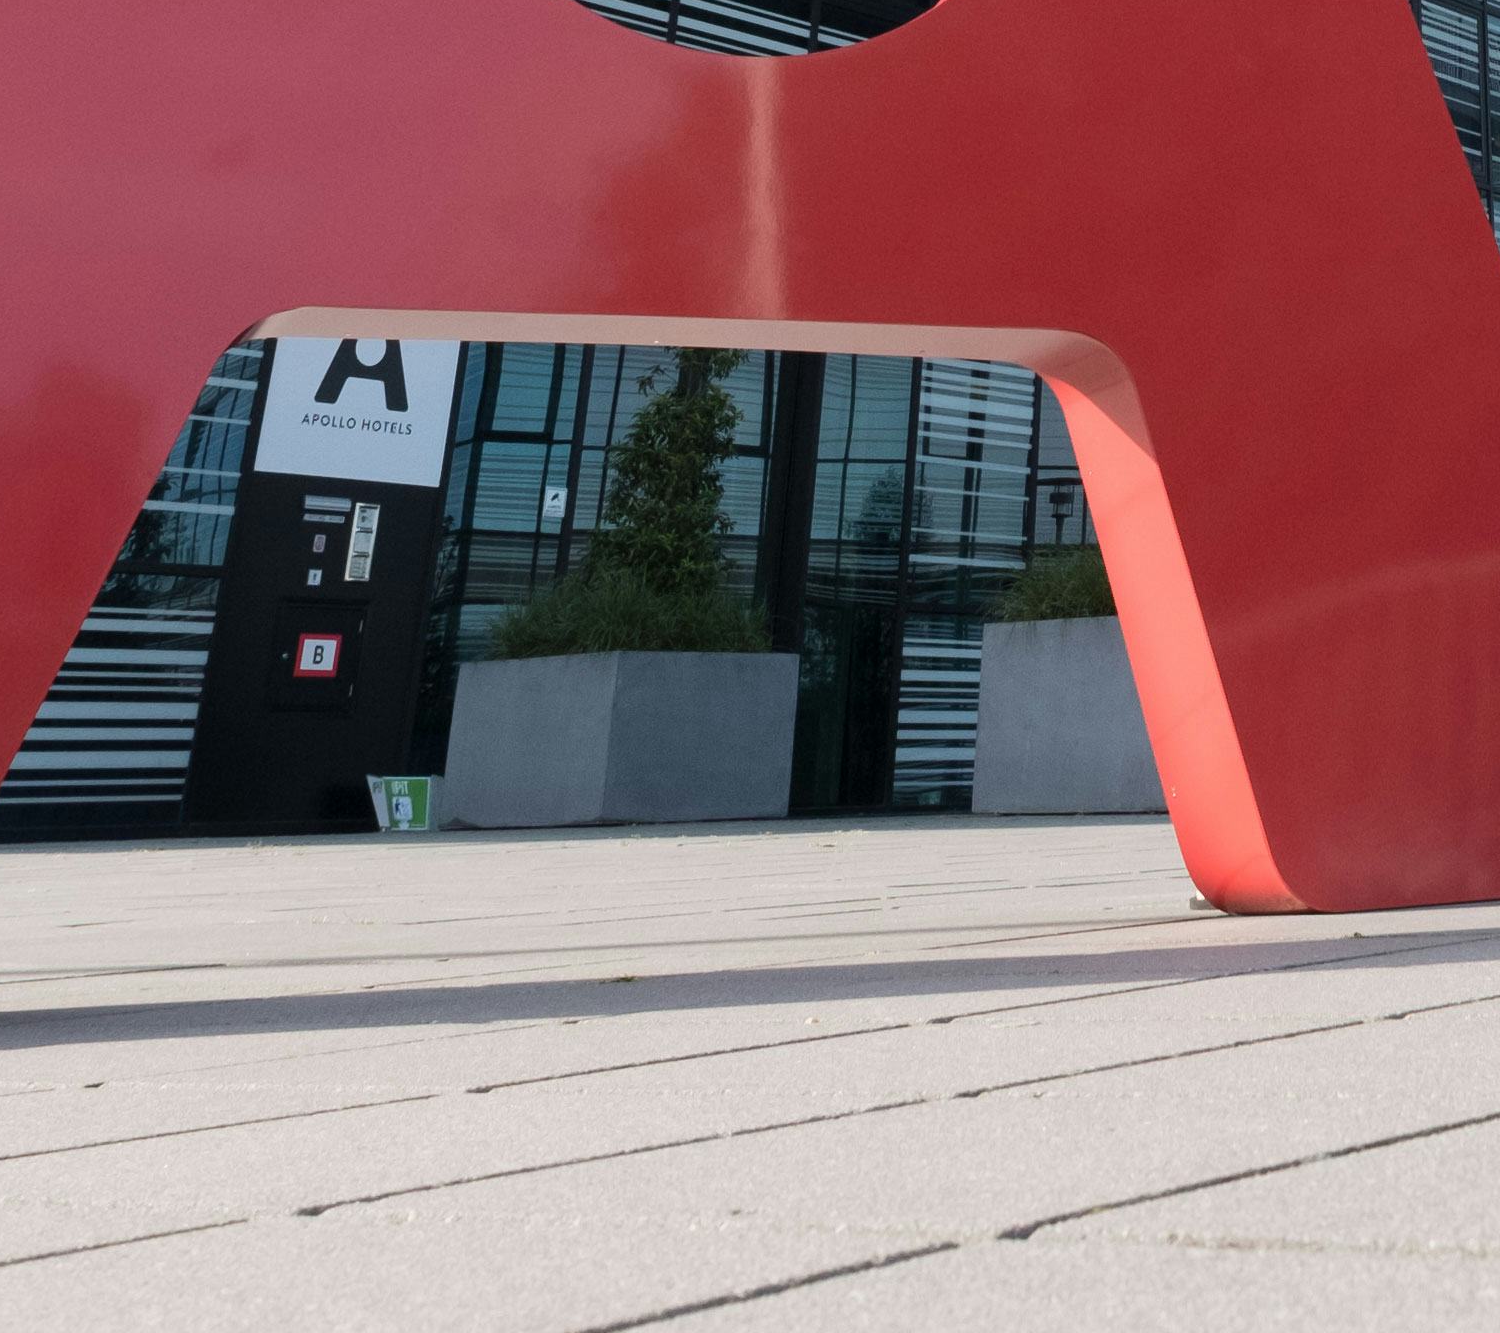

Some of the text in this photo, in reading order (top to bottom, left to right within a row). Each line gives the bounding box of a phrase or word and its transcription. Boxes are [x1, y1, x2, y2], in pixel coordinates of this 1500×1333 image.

[301, 413, 412, 435] APOLLO HOTELS
[313, 645, 324, 664] B
